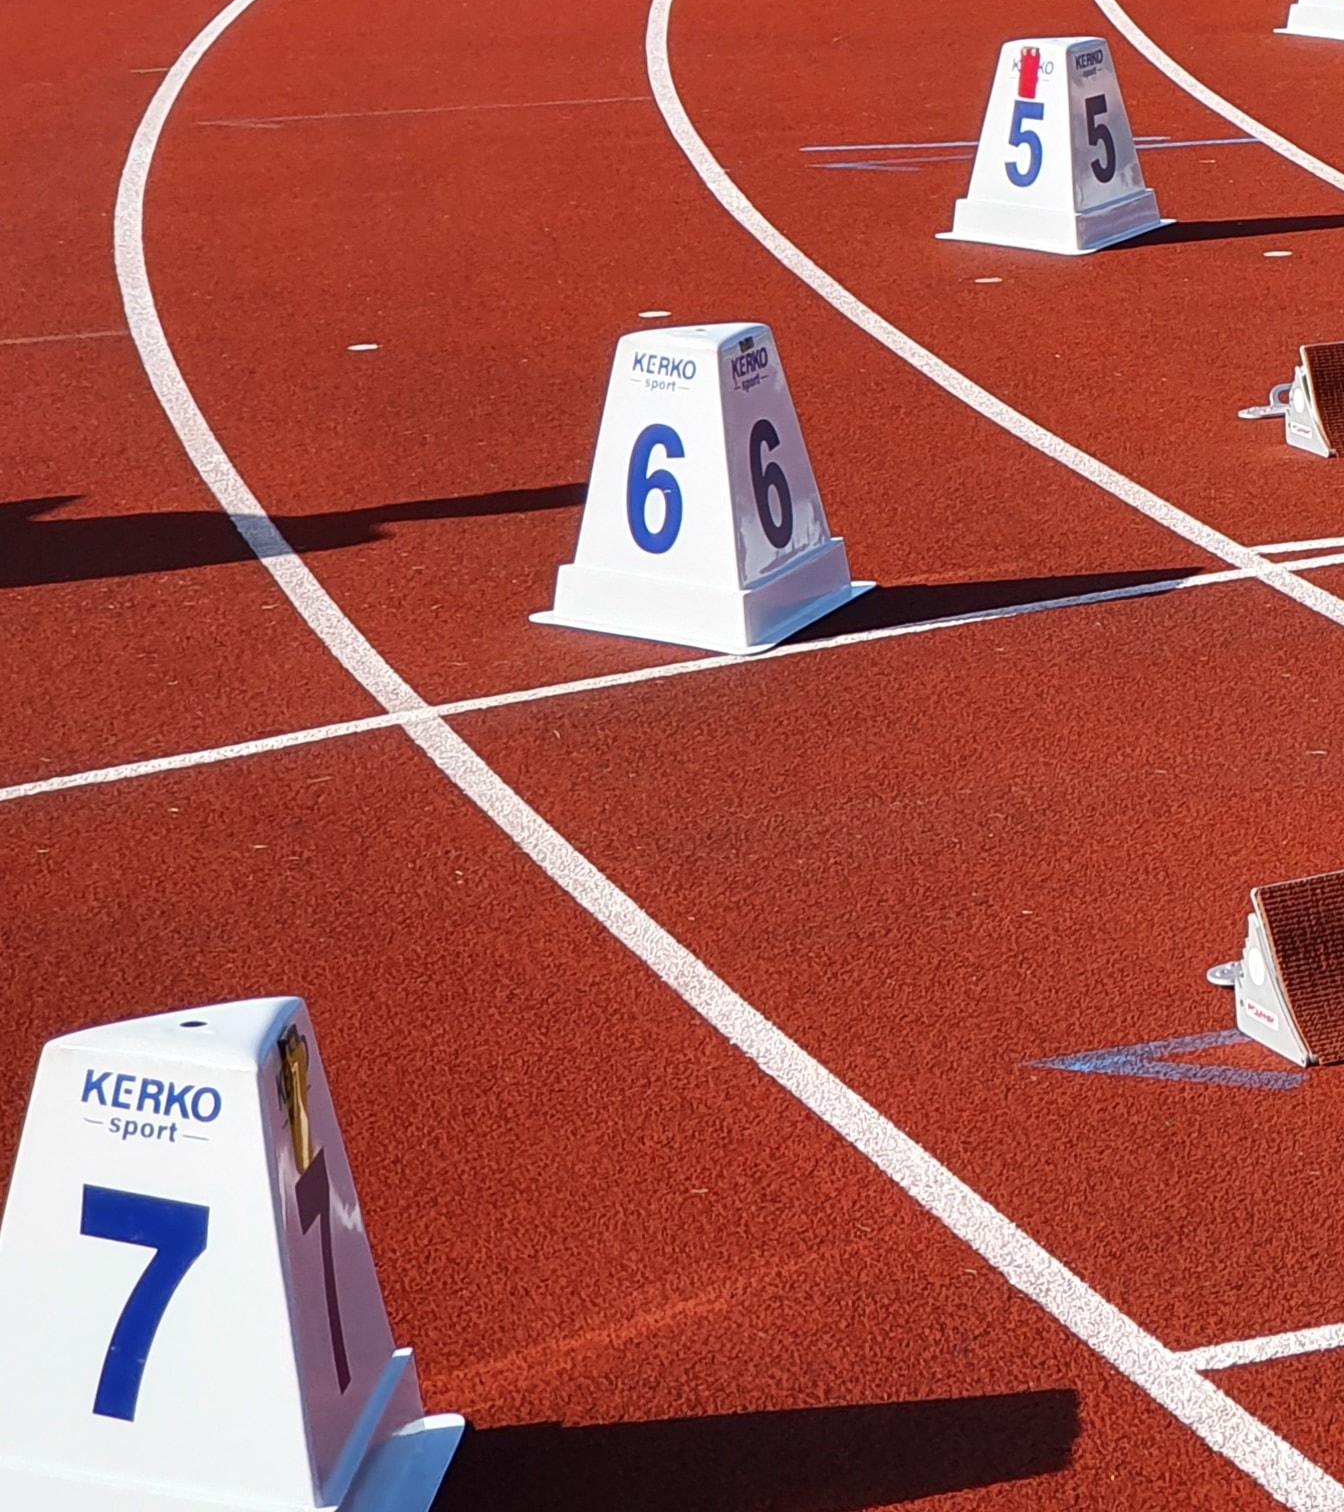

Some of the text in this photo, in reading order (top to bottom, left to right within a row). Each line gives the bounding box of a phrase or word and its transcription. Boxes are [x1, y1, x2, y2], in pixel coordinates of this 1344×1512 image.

[1075, 48, 1104, 70] KERKO
[1004, 99, 1045, 188] 5
[1084, 93, 1116, 184] 5
[632, 351, 697, 380] KERKO
[644, 377, 676, 392] sport
[731, 347, 769, 378] KERKO
[626, 423, 685, 555] 6
[749, 419, 794, 549] 6
[80, 1068, 223, 1123] KERKO
[108, 1116, 178, 1144] sport
[80, 1183, 210, 1423] 7
